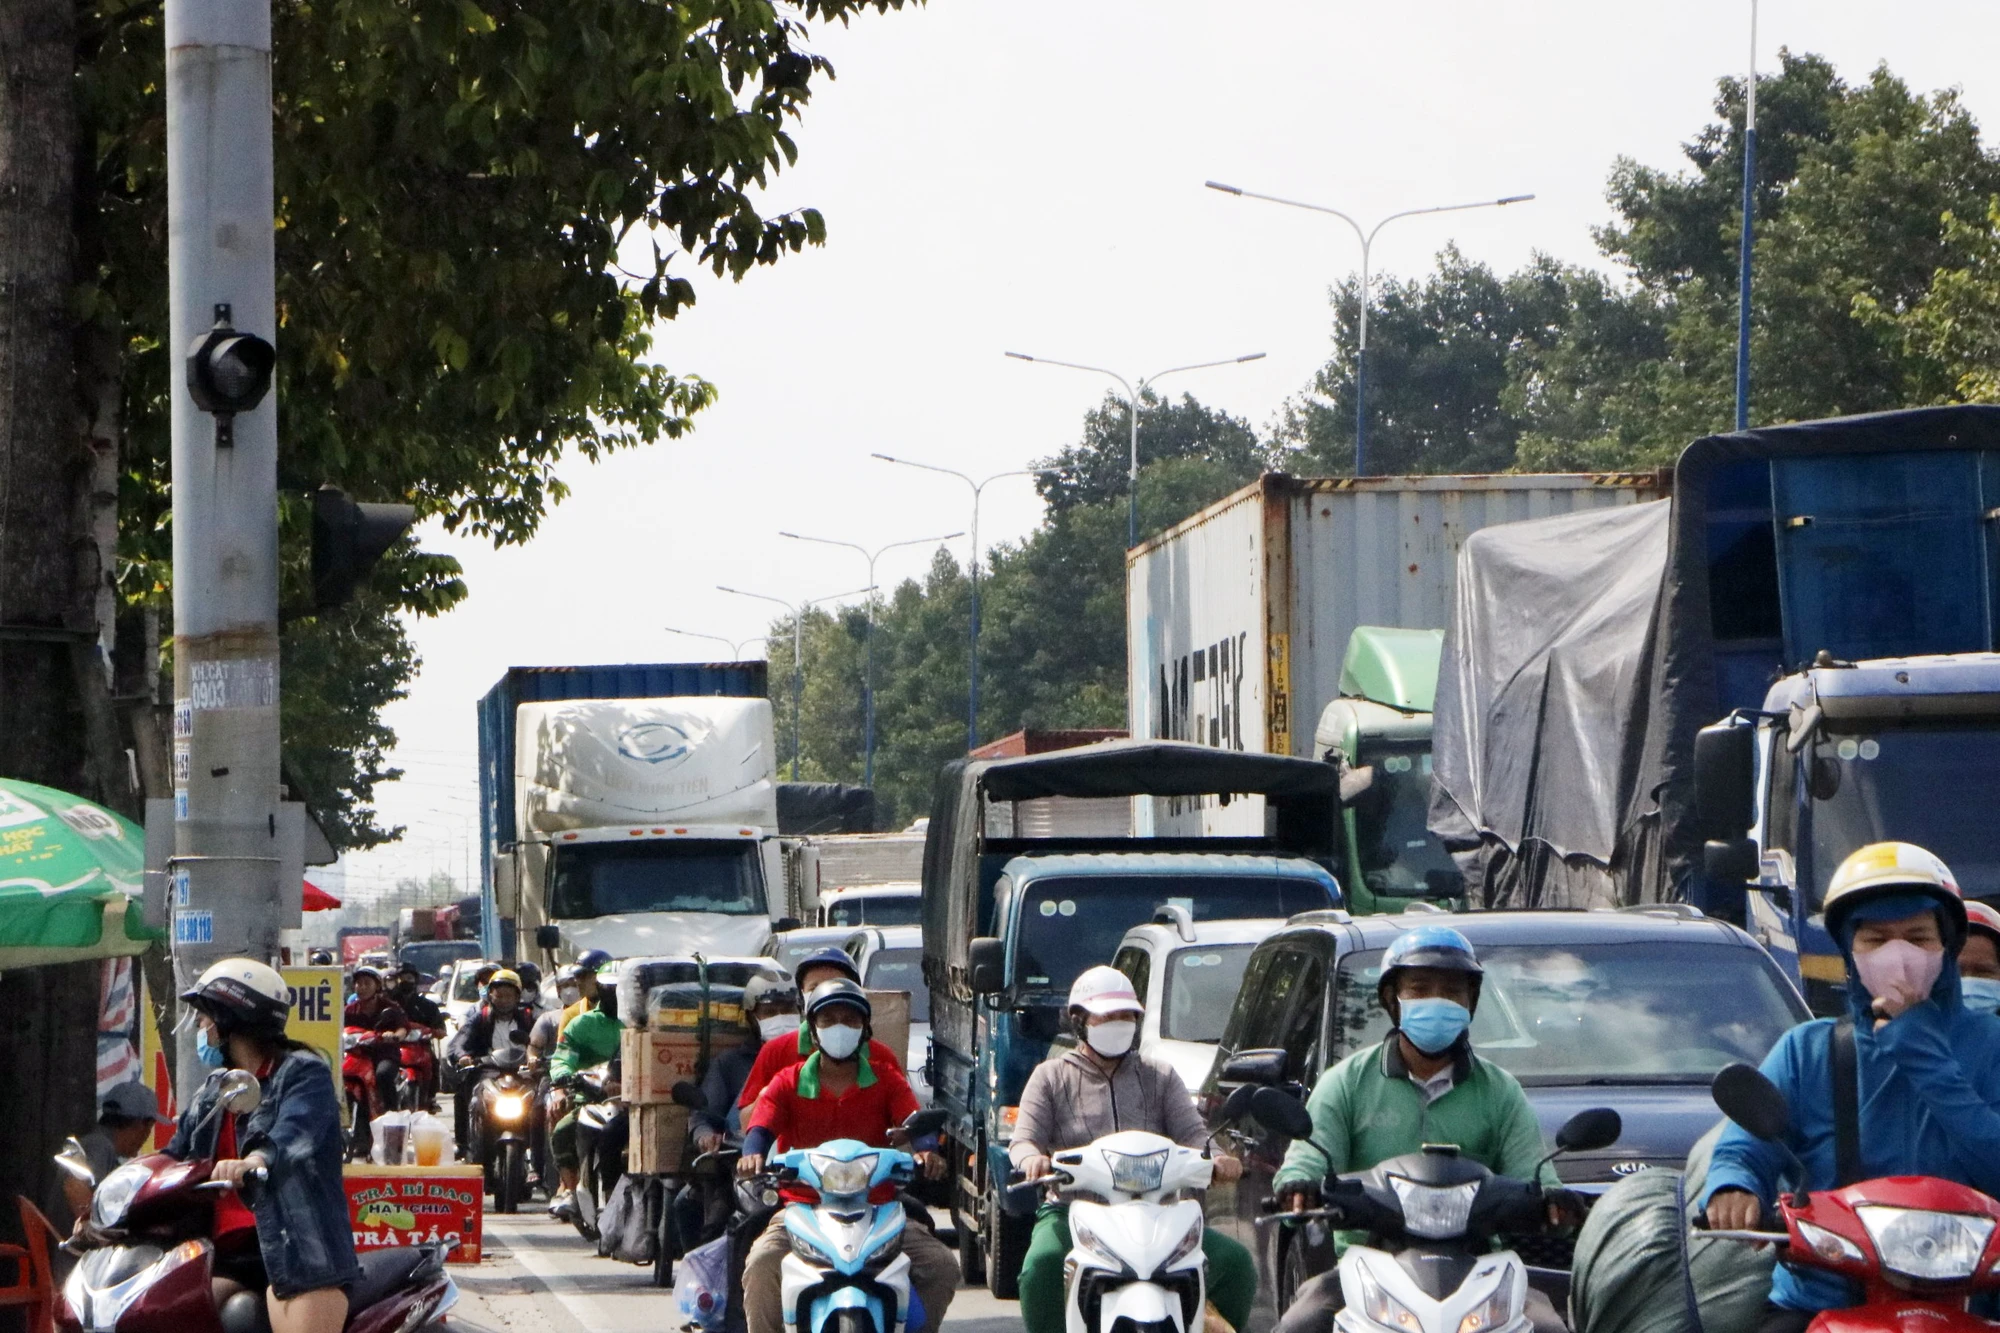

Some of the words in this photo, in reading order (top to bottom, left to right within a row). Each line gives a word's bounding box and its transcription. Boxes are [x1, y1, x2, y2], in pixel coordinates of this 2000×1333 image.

[1618, 1161, 1649, 1173] KIA
[353, 1183, 398, 1205] TRÀ
[402, 1182, 424, 1197] BÍ
[409, 1204, 451, 1215] CHIA
[352, 1227, 400, 1246] TRÀ
[1895, 1307, 1949, 1323] HONDA
